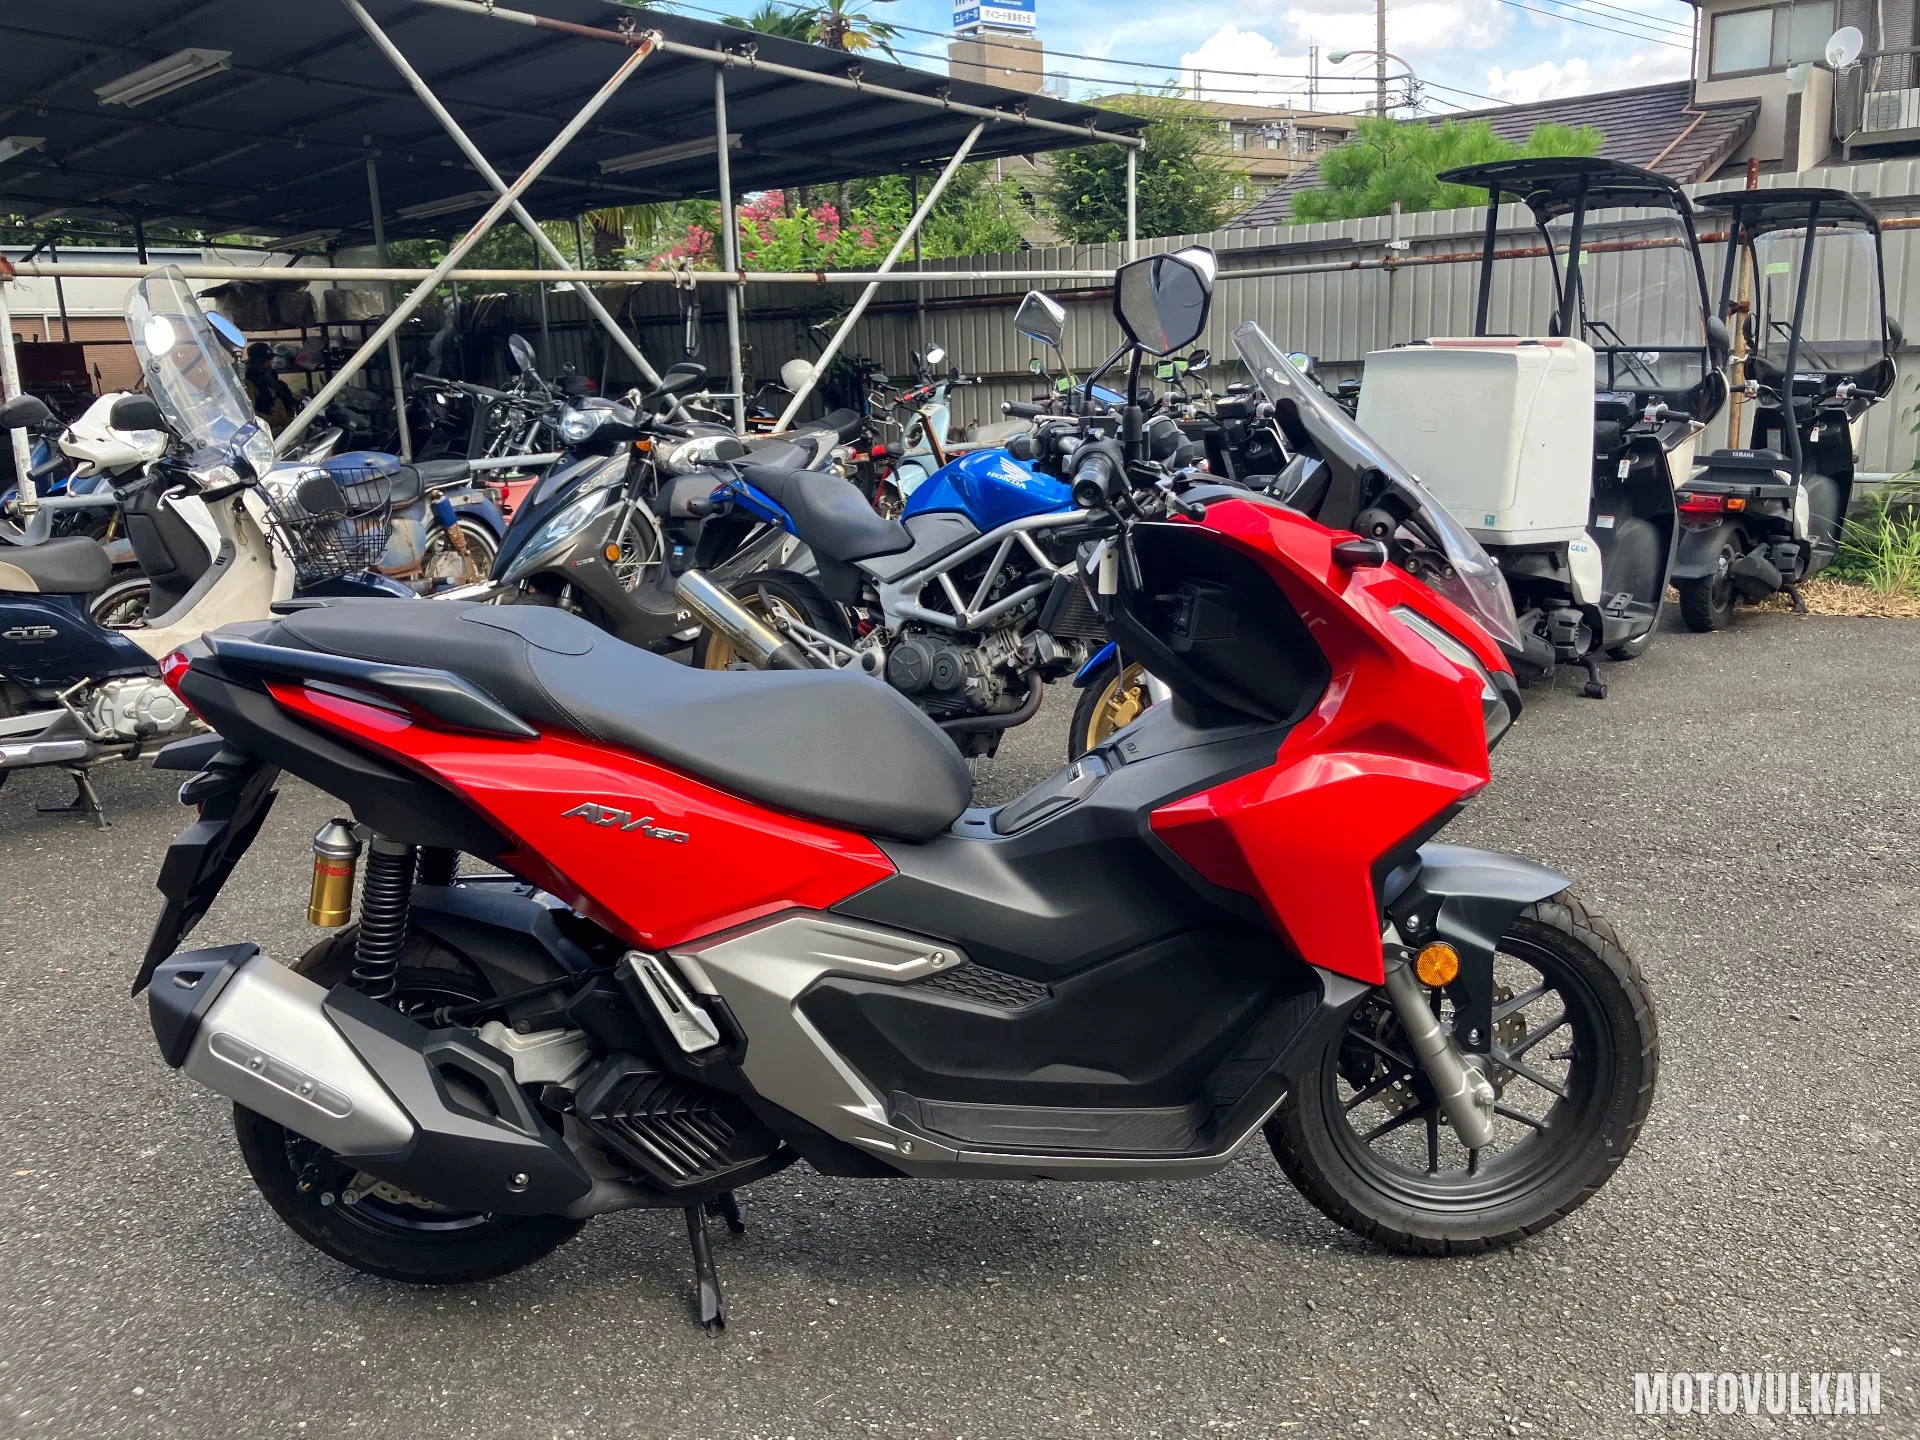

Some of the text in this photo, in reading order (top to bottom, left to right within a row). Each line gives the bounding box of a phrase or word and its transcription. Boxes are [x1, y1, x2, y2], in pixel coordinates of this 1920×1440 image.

[986, 471, 1026, 490] HONDA
[1571, 545, 1588, 553] GEAR
[2, 629, 58, 640] CUB
